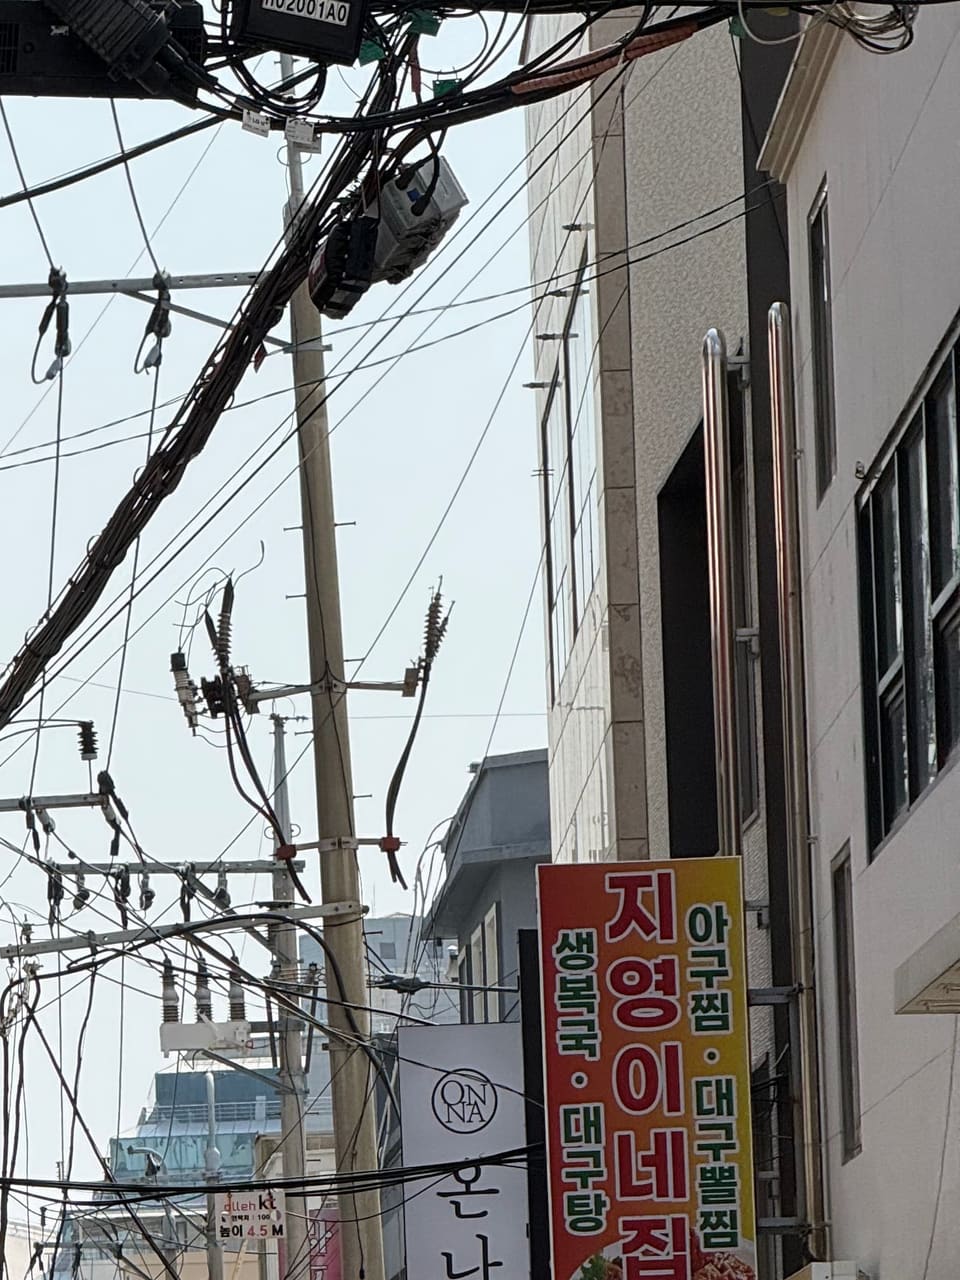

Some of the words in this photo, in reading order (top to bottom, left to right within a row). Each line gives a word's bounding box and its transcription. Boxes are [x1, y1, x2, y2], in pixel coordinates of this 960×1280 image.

[552, 928, 599, 1061] 생복국
[685, 902, 733, 1035] 아구찜
[259, 1194, 277, 1210] kt
[560, 1103, 610, 1237] 대구탕
[692, 1075, 739, 1252] 대구뽈찜
[220, 1225, 243, 1238] 높이
[247, 1224, 268, 1237] 4.5
[272, 1224, 283, 1236] M
